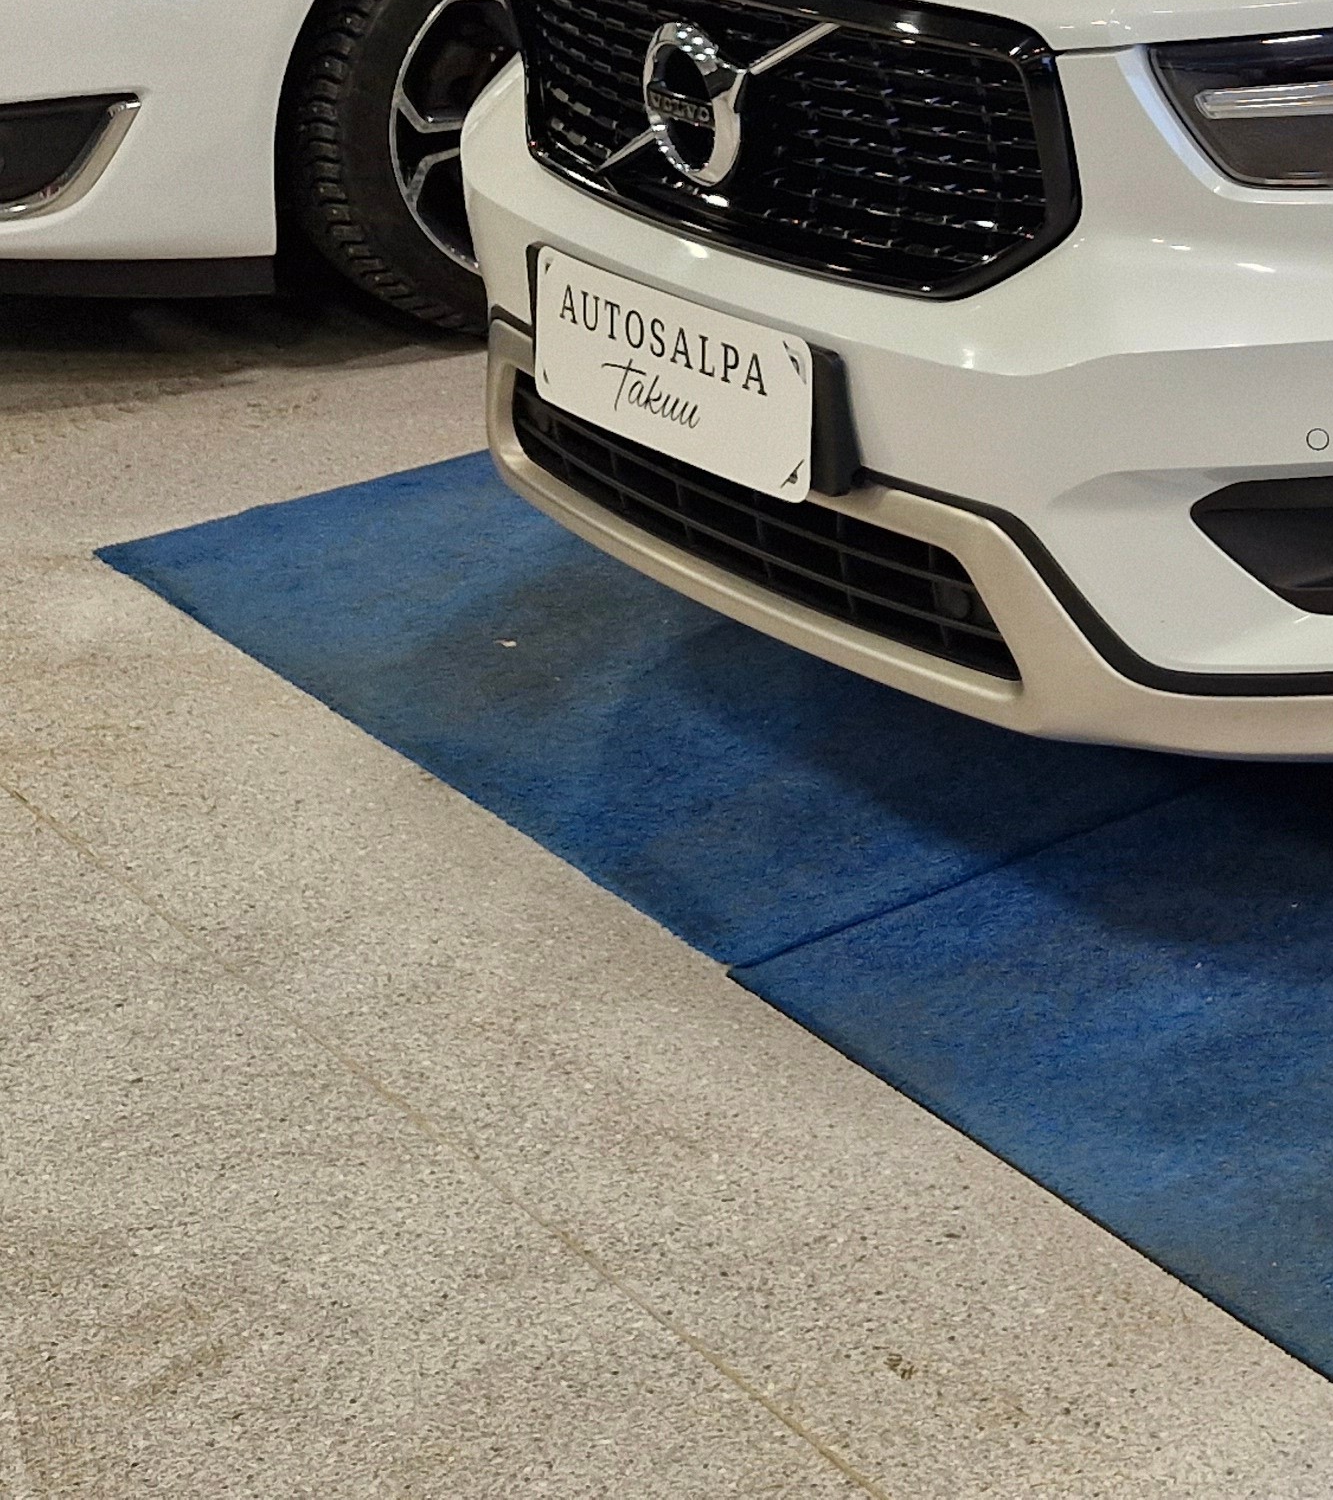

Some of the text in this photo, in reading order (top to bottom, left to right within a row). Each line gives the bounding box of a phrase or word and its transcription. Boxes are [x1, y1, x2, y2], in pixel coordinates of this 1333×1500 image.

[648, 90, 711, 123] VOLVO
[558, 283, 768, 397] AUTOSALPA
[600, 357, 701, 430] Takuu
